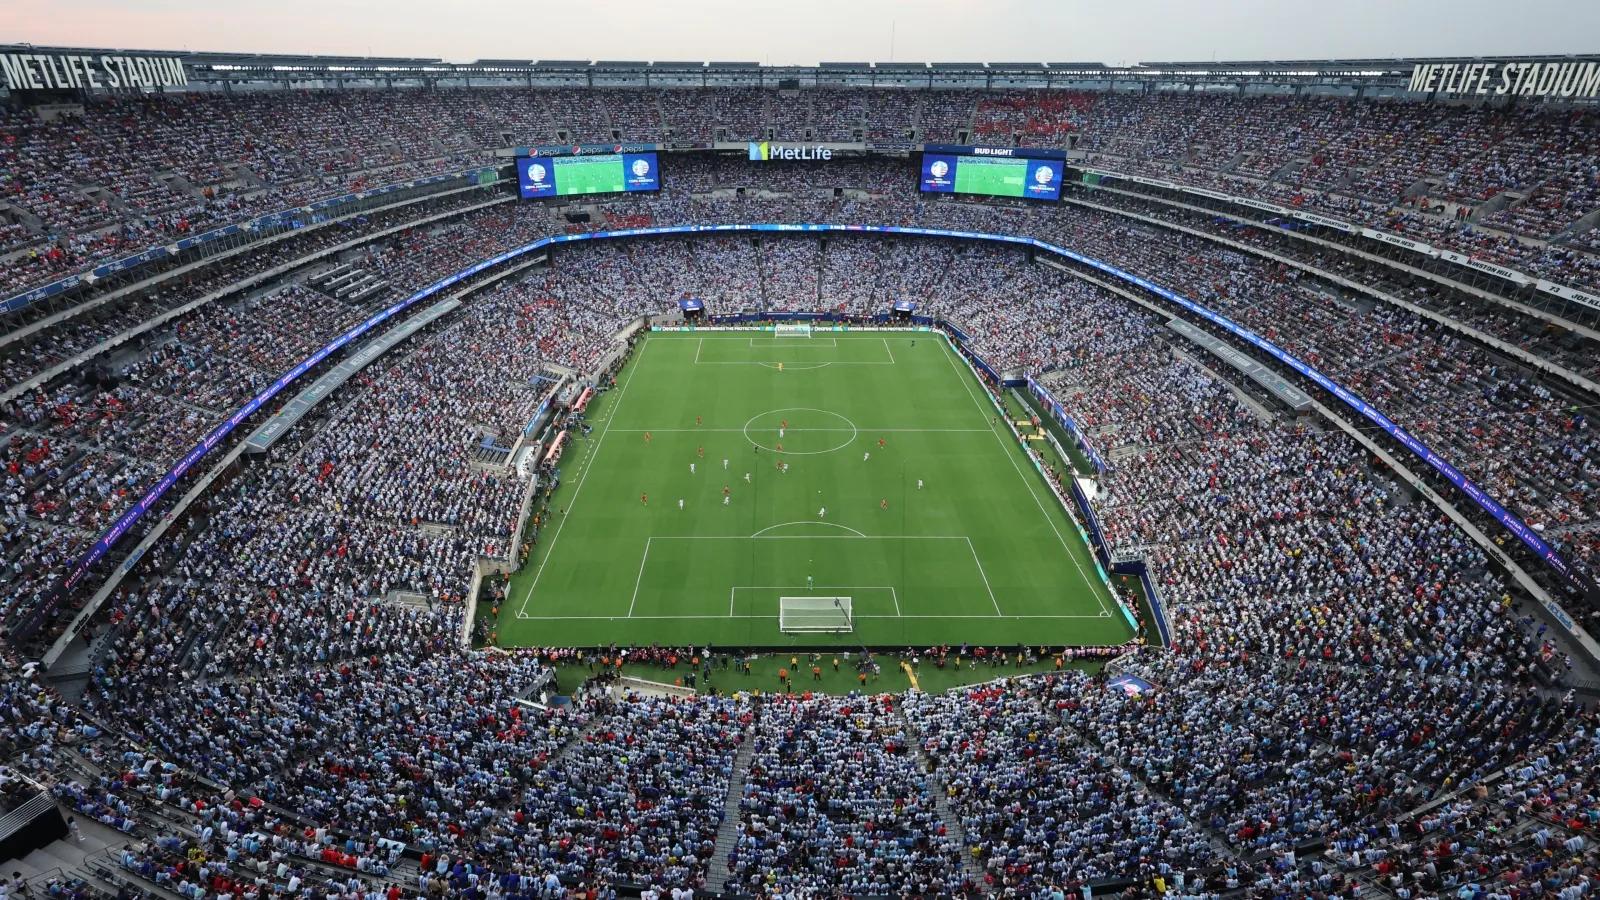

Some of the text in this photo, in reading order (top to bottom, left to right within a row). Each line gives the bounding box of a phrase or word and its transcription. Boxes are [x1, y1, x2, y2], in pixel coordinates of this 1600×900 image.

[0, 54, 188, 89] METLIFE STADIUM
[1408, 62, 1600, 98] METLIFE STADIUM
[539, 149, 560, 158] pepsi
[622, 145, 644, 153] pepsi
[770, 145, 832, 160] MetLife
[1306, 215, 1321, 223] LARRY
[1321, 218, 1349, 230] GRANTHAM
[1386, 236, 1416, 248] LEON HESS
[1466, 260, 1497, 273] WINSTON
[1496, 270, 1512, 278] HILL
[1571, 294, 1589, 303] JOE
[312, 384, 327, 398] MetLife
[264, 422, 281, 436] MetLife
[176, 462, 186, 472] LATAM
[190, 450, 200, 460] DELTA
[1431, 456, 1442, 466] LATAM
[1447, 470, 1458, 480] DELTA
[144, 479, 170, 503] LATAM DELTA
[1467, 485, 1497, 512] LATAM DELTA
[108, 512, 137, 540] LATAM DELTA
[1508, 518, 1541, 550] LATAM DELTA
[68, 550, 100, 583] LATAM DELTA
[124, 549, 144, 570] HCLTech
[1490, 548, 1506, 566] verizon
[1552, 556, 1589, 592] LATAM DELTA
[45, 594, 59, 610] DELTA
[72, 613, 90, 634] verizon
[1547, 602, 1572, 630] HCLTech
